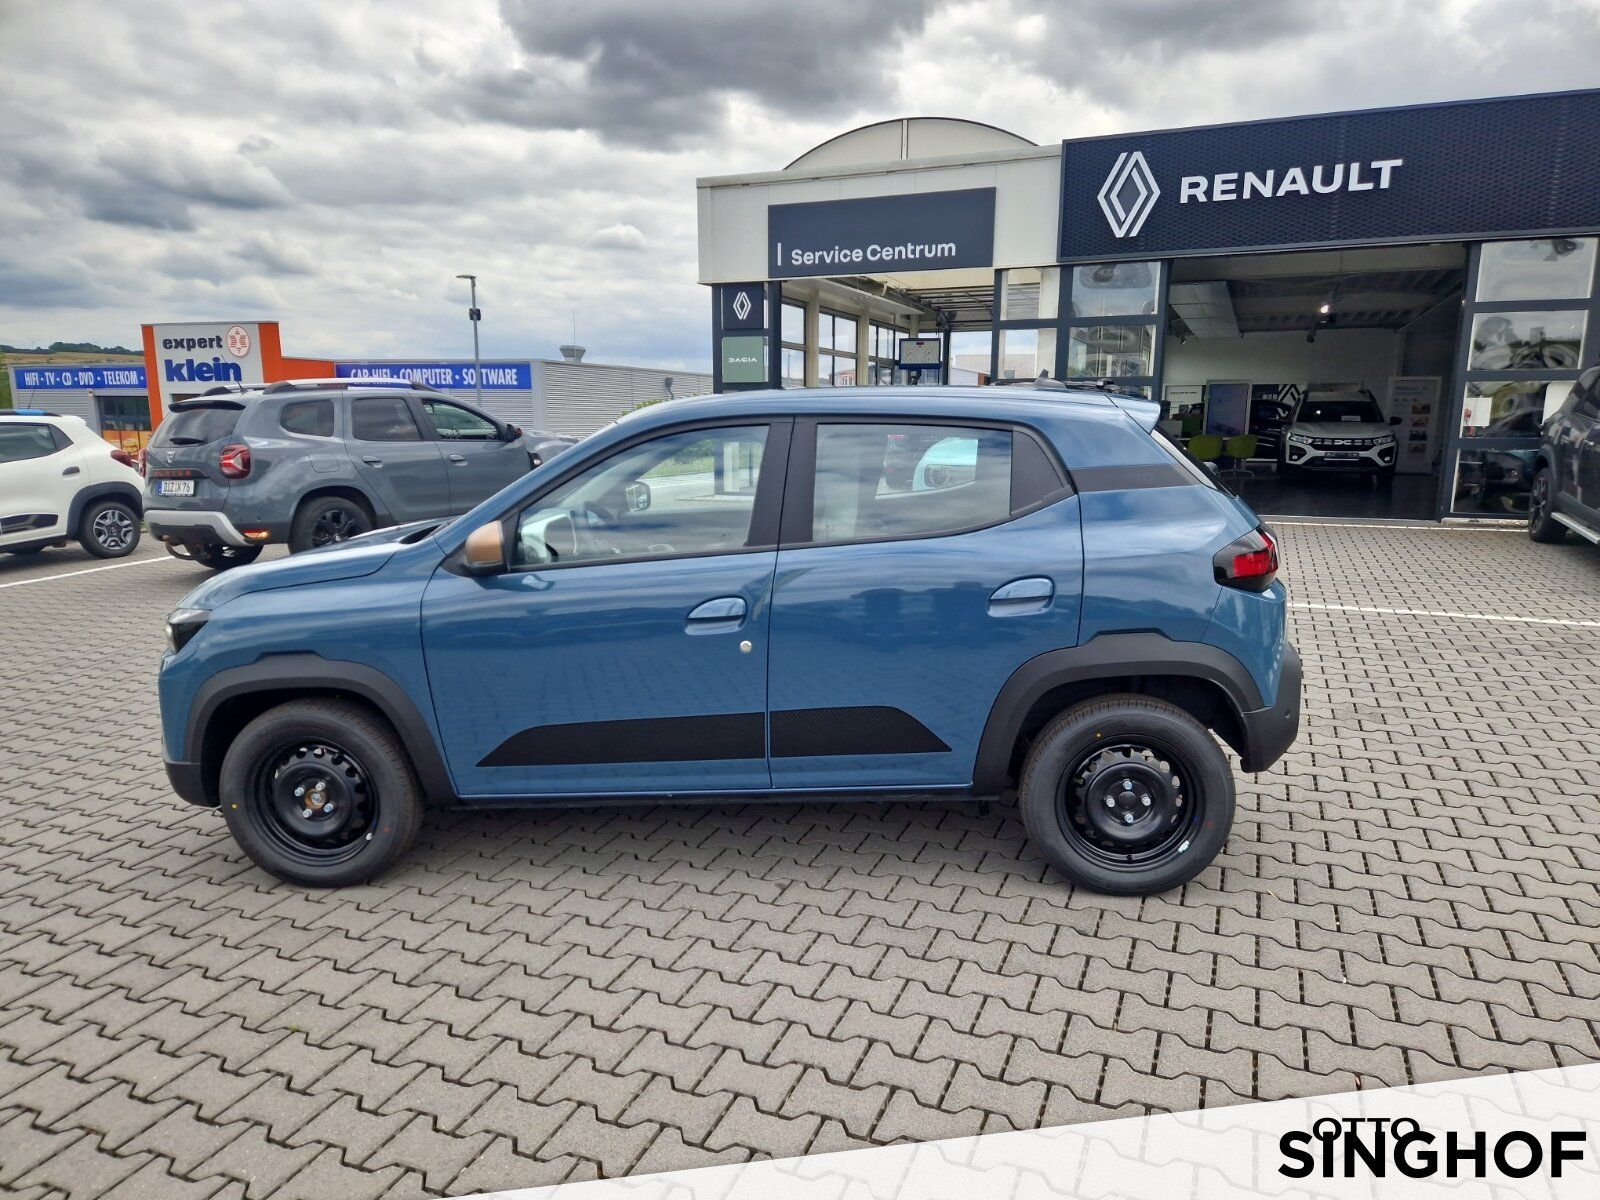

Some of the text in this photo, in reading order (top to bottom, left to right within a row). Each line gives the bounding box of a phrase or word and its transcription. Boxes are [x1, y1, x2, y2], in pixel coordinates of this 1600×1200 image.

[1179, 158, 1404, 204] RENAULT
[791, 242, 957, 266] Service Centrum
[162, 335, 223, 352] expert
[24, 370, 138, 386] HIFI TV CD DVD TELEKOM
[164, 357, 242, 381] klein
[400, 368, 453, 385] COMPUTER
[462, 368, 518, 386] SOTWARE
